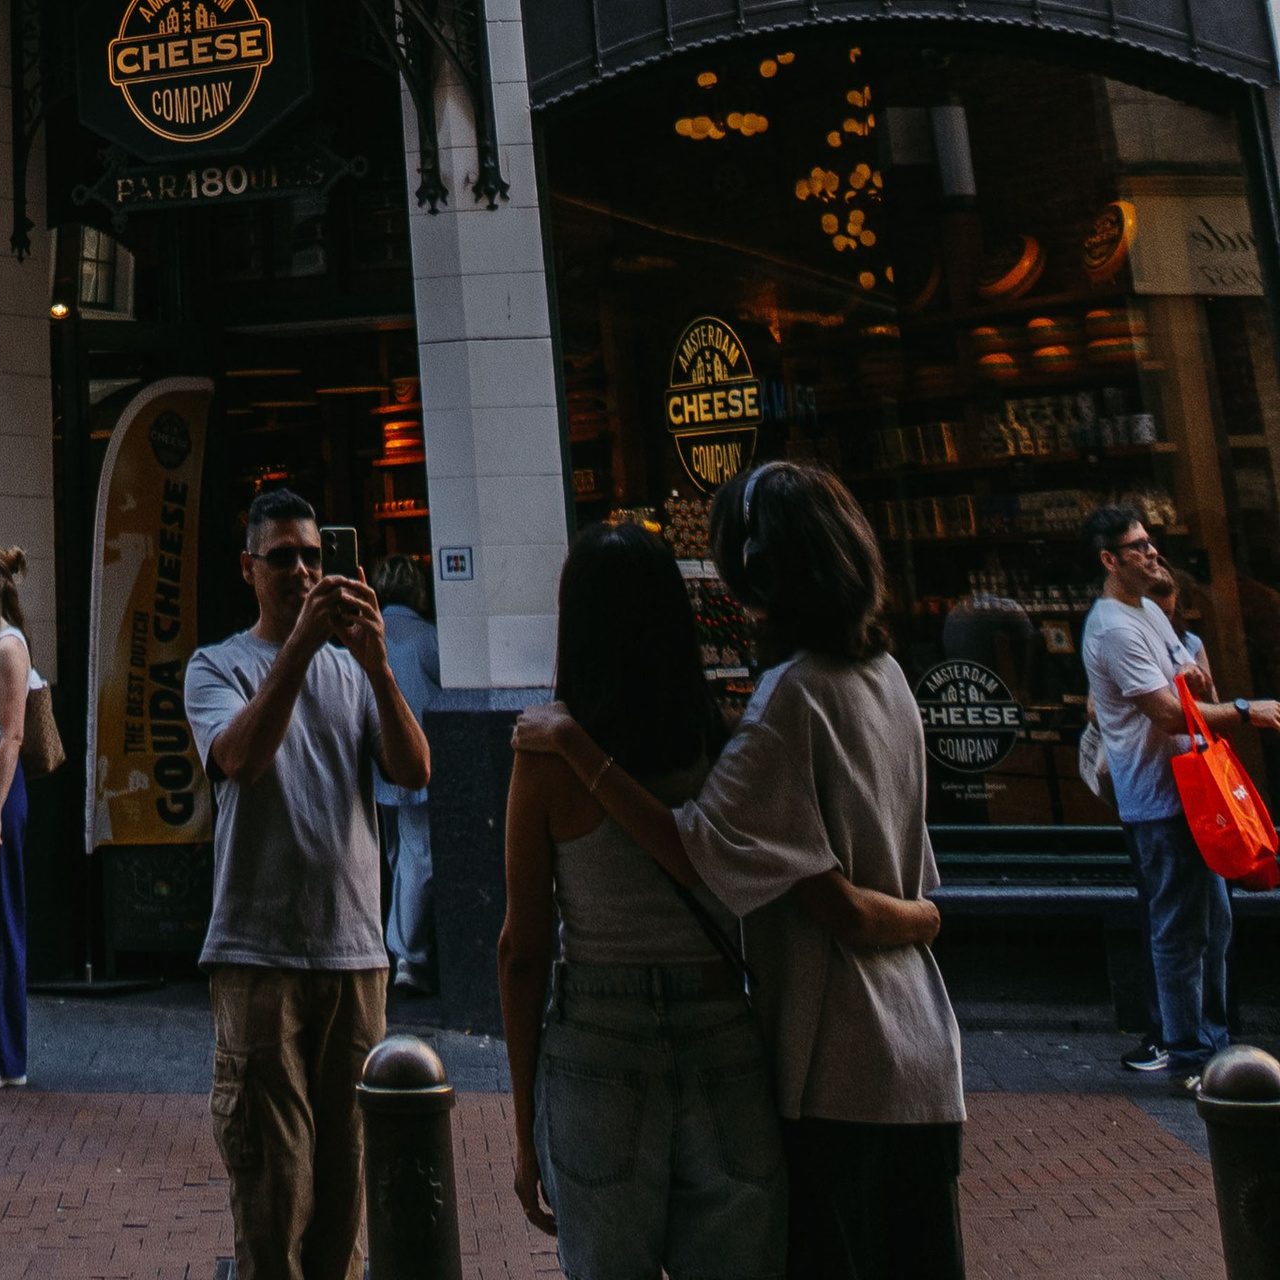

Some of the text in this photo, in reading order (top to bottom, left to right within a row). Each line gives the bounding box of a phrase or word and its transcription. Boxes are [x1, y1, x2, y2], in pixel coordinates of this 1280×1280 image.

[116, 29, 263, 74] CHEESE
[152, 81, 233, 124] COMPANY
[678, 324, 740, 373] AMSTERDAM
[668, 386, 759, 425] CHEESE
[692, 442, 742, 484] COMPANY
[153, 479, 188, 643] CHEESE
[124, 610, 149, 755] THE BEST DUTCH
[925, 664, 999, 693] AMSTERDAM
[150, 661, 195, 826] GOUDA
[938, 738, 999, 763] COMPANY
